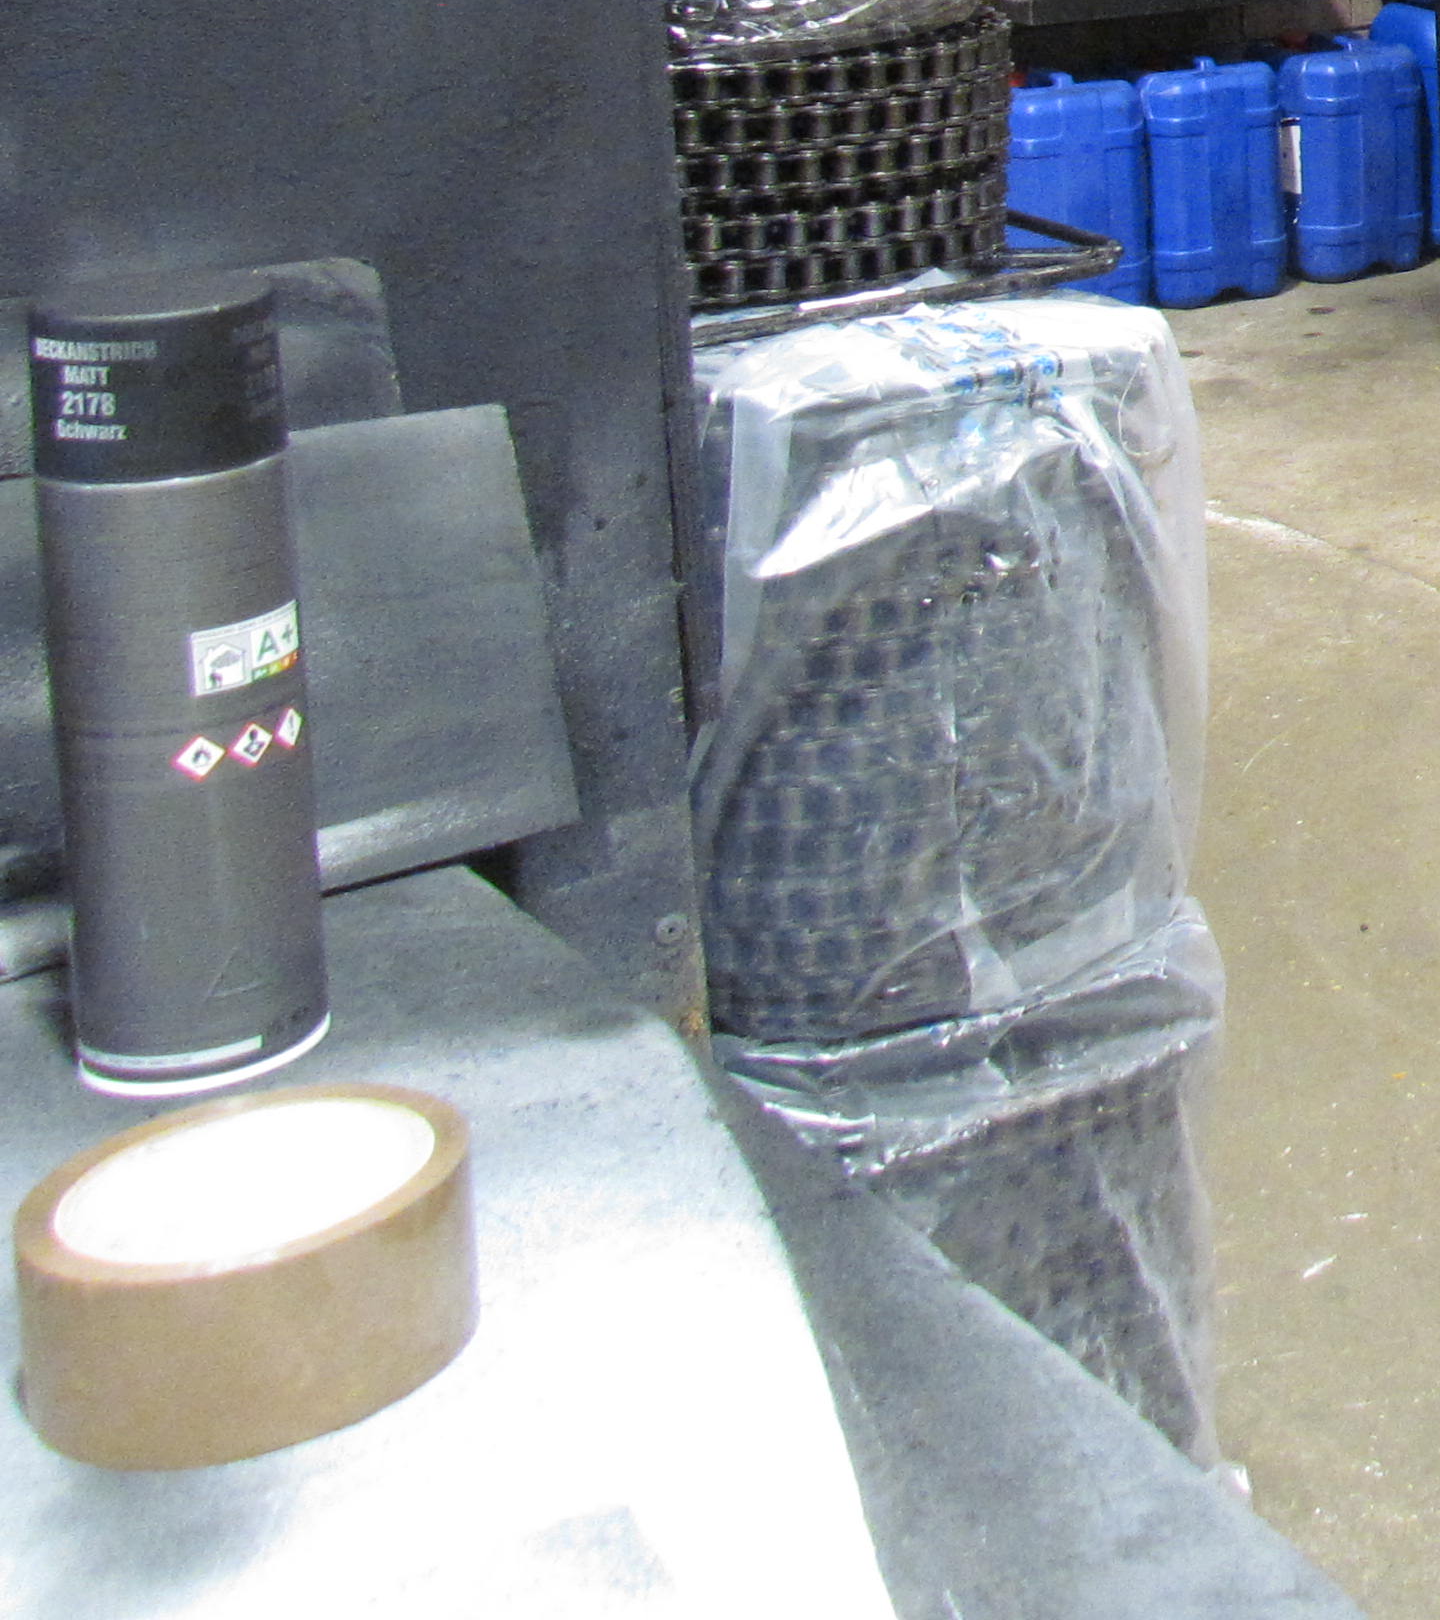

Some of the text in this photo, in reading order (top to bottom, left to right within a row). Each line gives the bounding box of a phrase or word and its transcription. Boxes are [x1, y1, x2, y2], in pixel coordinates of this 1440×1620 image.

[63, 365, 111, 385] MATT
[61, 390, 117, 415] 2178
[56, 419, 128, 440] Schwarz
